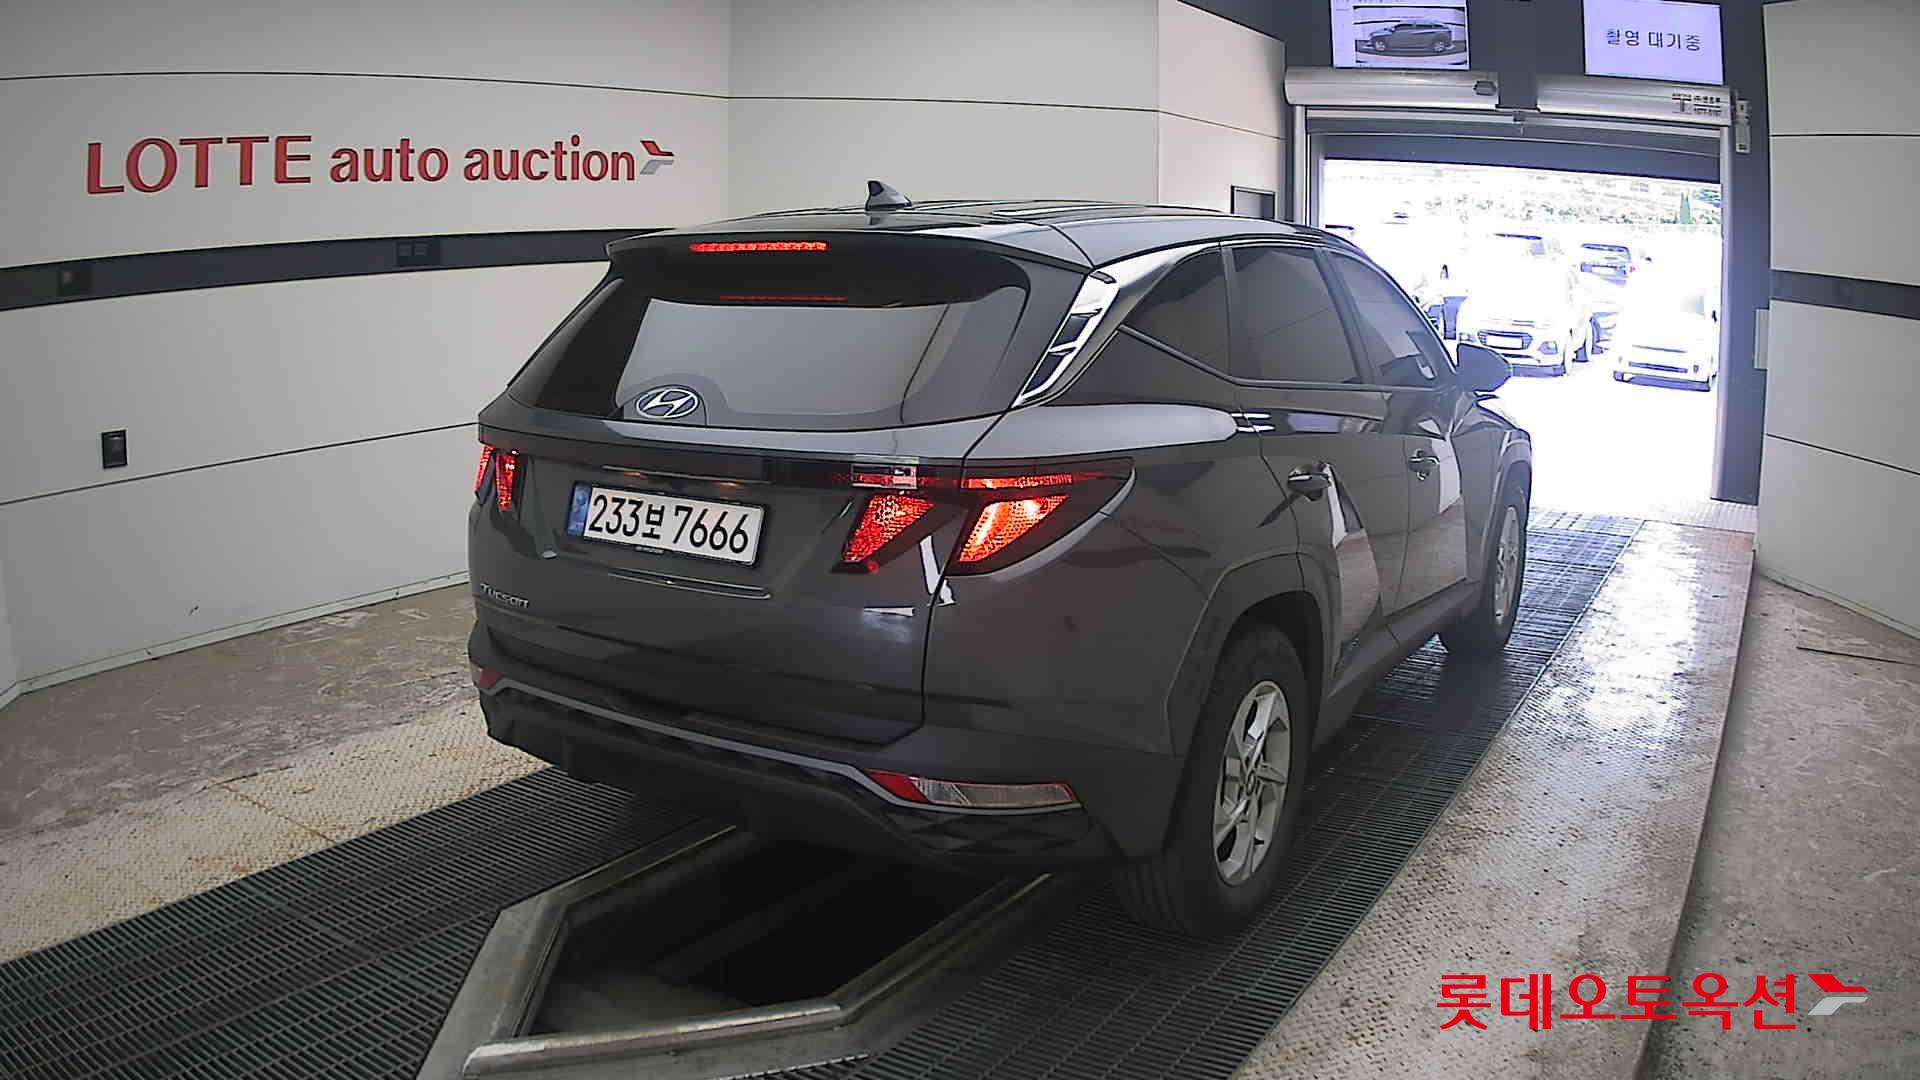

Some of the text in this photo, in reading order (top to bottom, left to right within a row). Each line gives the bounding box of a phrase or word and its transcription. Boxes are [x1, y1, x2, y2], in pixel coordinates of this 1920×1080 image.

[1647, 31, 1701, 52] 대기중
[87, 135, 636, 194] LOTTE auto auction
[588, 494, 749, 554] 233보 7666
